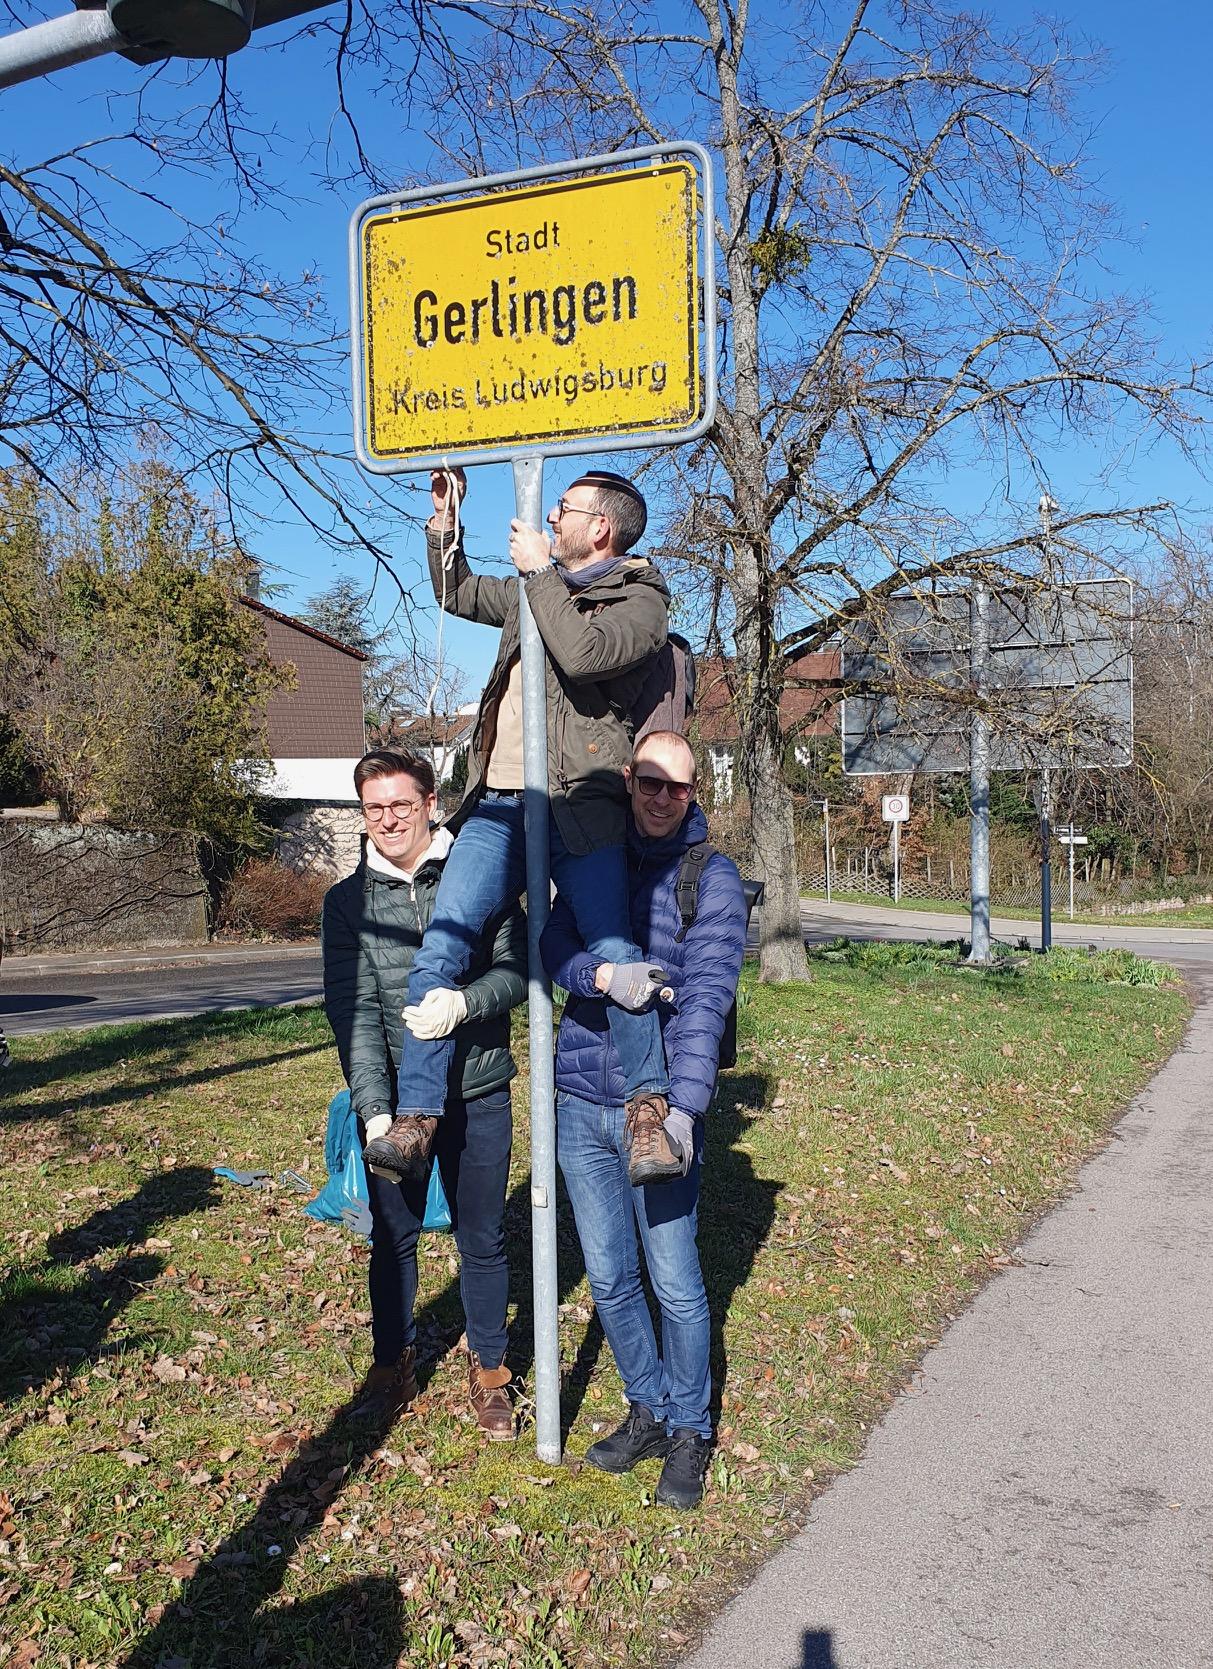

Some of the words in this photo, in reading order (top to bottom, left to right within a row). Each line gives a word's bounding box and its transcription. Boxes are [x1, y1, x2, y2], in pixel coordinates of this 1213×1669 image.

[486, 221, 560, 258] Stadt
[414, 275, 637, 348] Gerlingen
[393, 377, 467, 416] Kreis
[475, 360, 667, 408] Ludwigsburg
